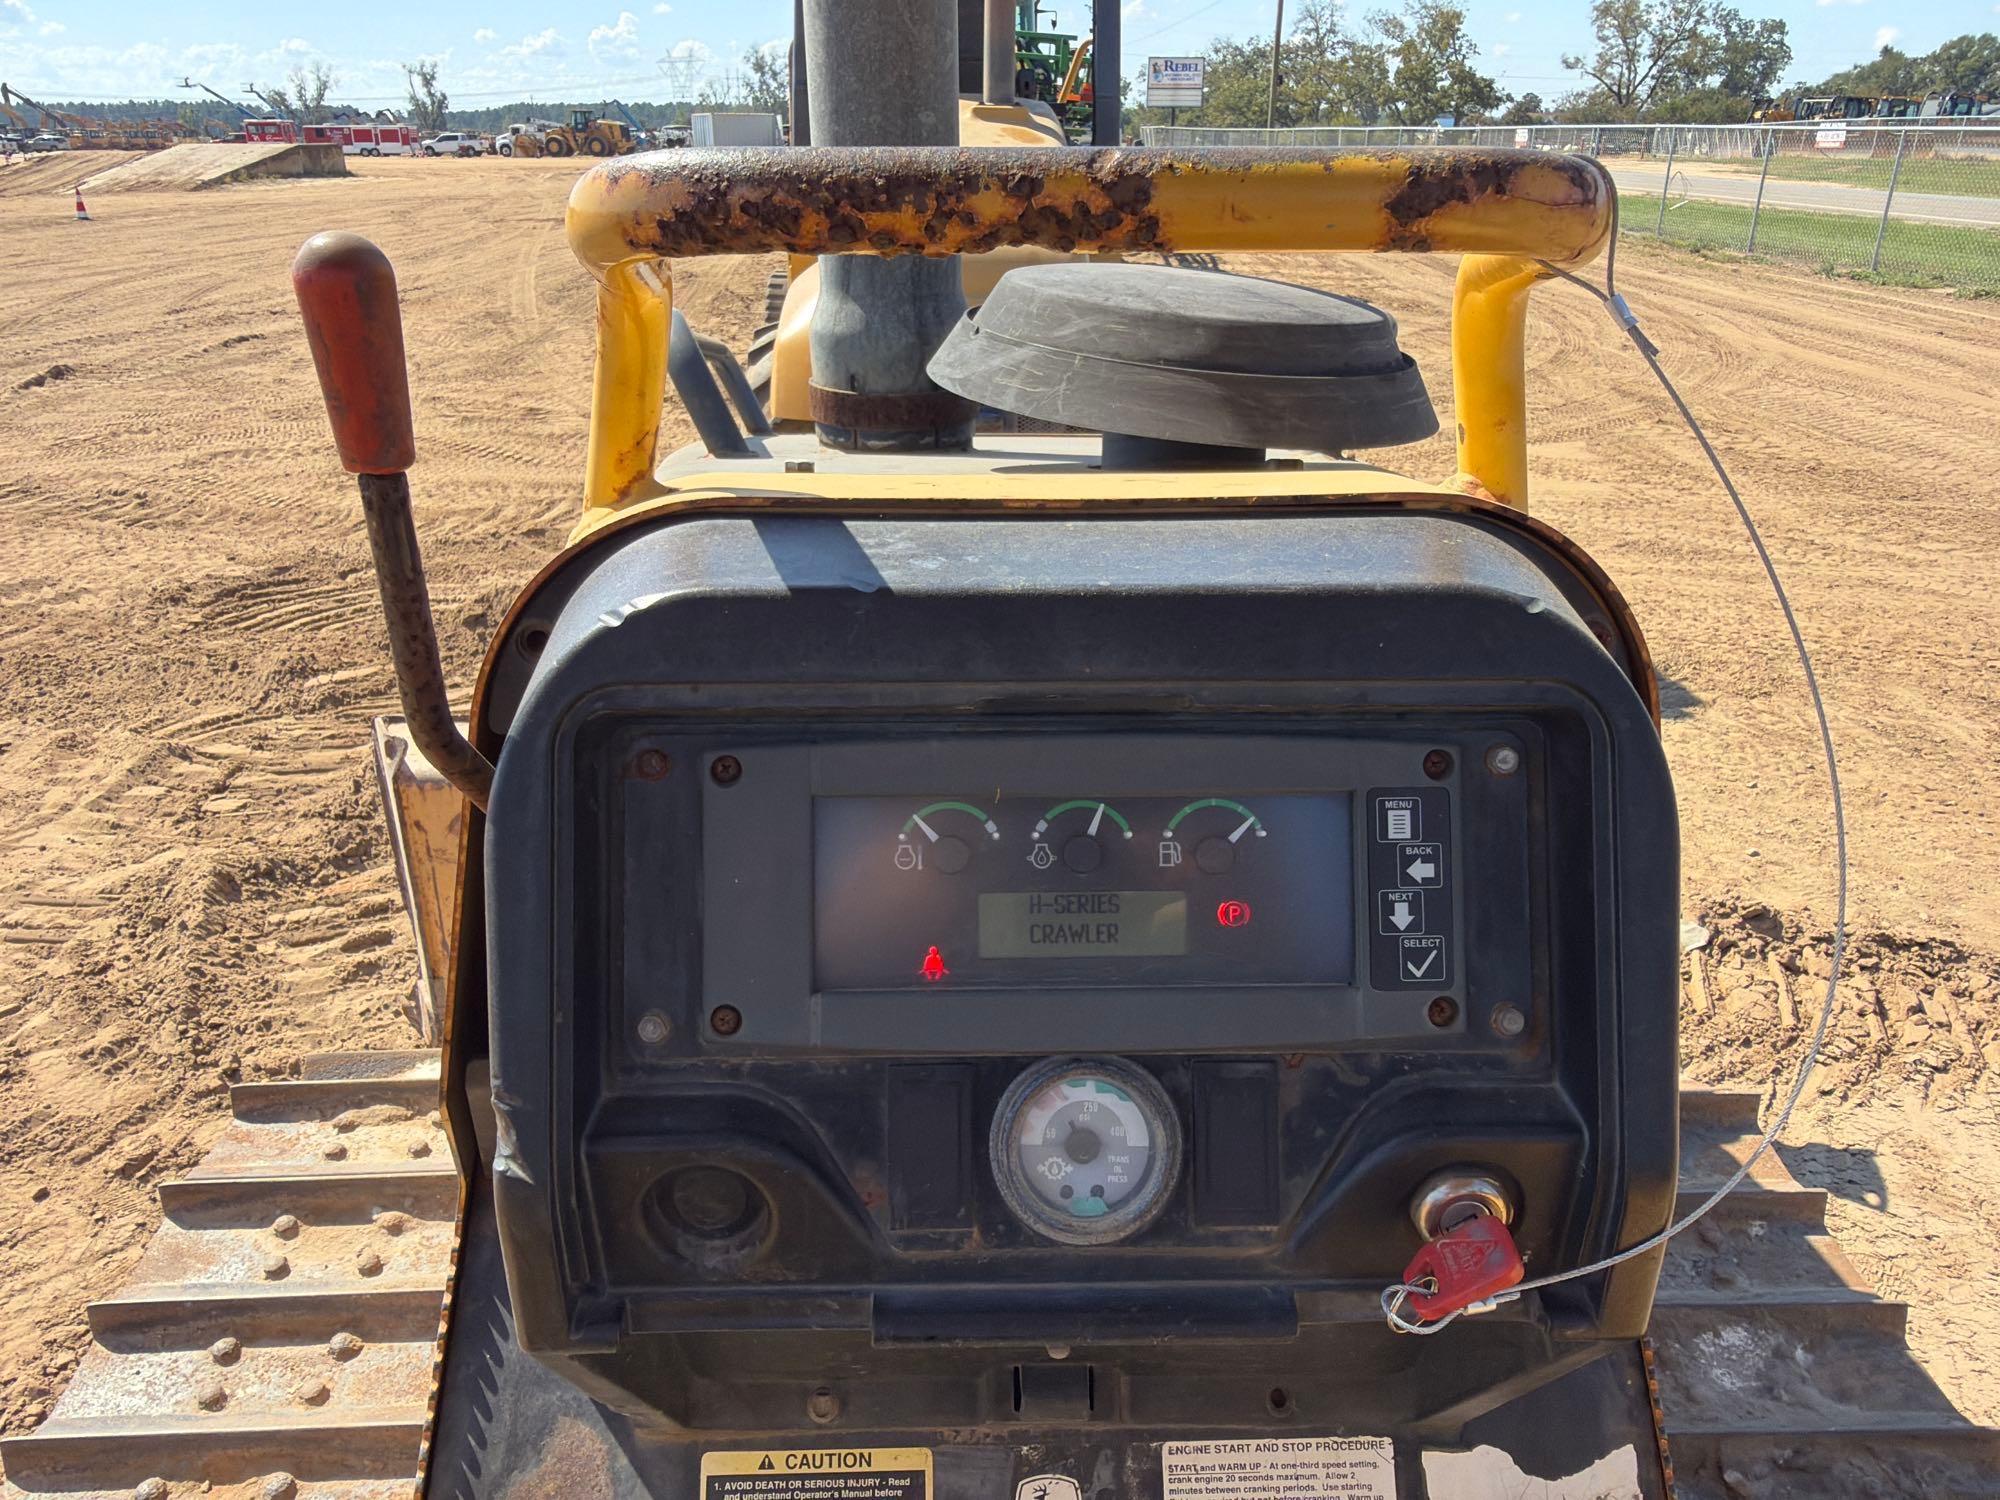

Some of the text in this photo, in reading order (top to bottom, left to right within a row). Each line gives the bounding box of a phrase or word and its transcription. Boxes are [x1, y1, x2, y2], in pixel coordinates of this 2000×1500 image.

[1164, 60, 1201, 72] REBEL
[1385, 800, 1412, 809] MENU
[1406, 847, 1432, 855] BACK
[1029, 893, 1121, 914] H-SERIES
[1388, 893, 1413, 902] NEXT
[1030, 922, 1119, 944] CRAWLER
[1403, 939, 1440, 947] SELECT
[1110, 1126, 1125, 1137] 400
[1107, 1155, 1130, 1164] TRANS
[1107, 1175, 1128, 1183] PRESS
[1168, 1440, 1386, 1455] ENGINE START AND STOP PROCEDURE
[785, 1452, 872, 1470] CAUTION
[1168, 1464, 1197, 1473] START
[1199, 1464, 1216, 1472] and
[1218, 1463, 1247, 1471] WARM
[1269, 1462, 1279, 1470] At
[1281, 1461, 1320, 1469] one-third
[1322, 1460, 1347, 1470] speed
[1168, 1471, 1356, 1485] crank engine 20 seconds maximum. Allow 2
[714, 1482, 722, 1491] 1.
[724, 1482, 753, 1490] AVOID
[755, 1481, 786, 1490] DEATH
[788, 1480, 802, 1489] OR
[804, 1479, 845, 1488] SERIOUS
[847, 1478, 881, 1487] INJURY
[888, 1478, 910, 1486] Read
[1169, 1482, 1373, 1496] minutes between cranking periods. Use starting
[724, 1488, 903, 1500] and understand Operator's Manual before
